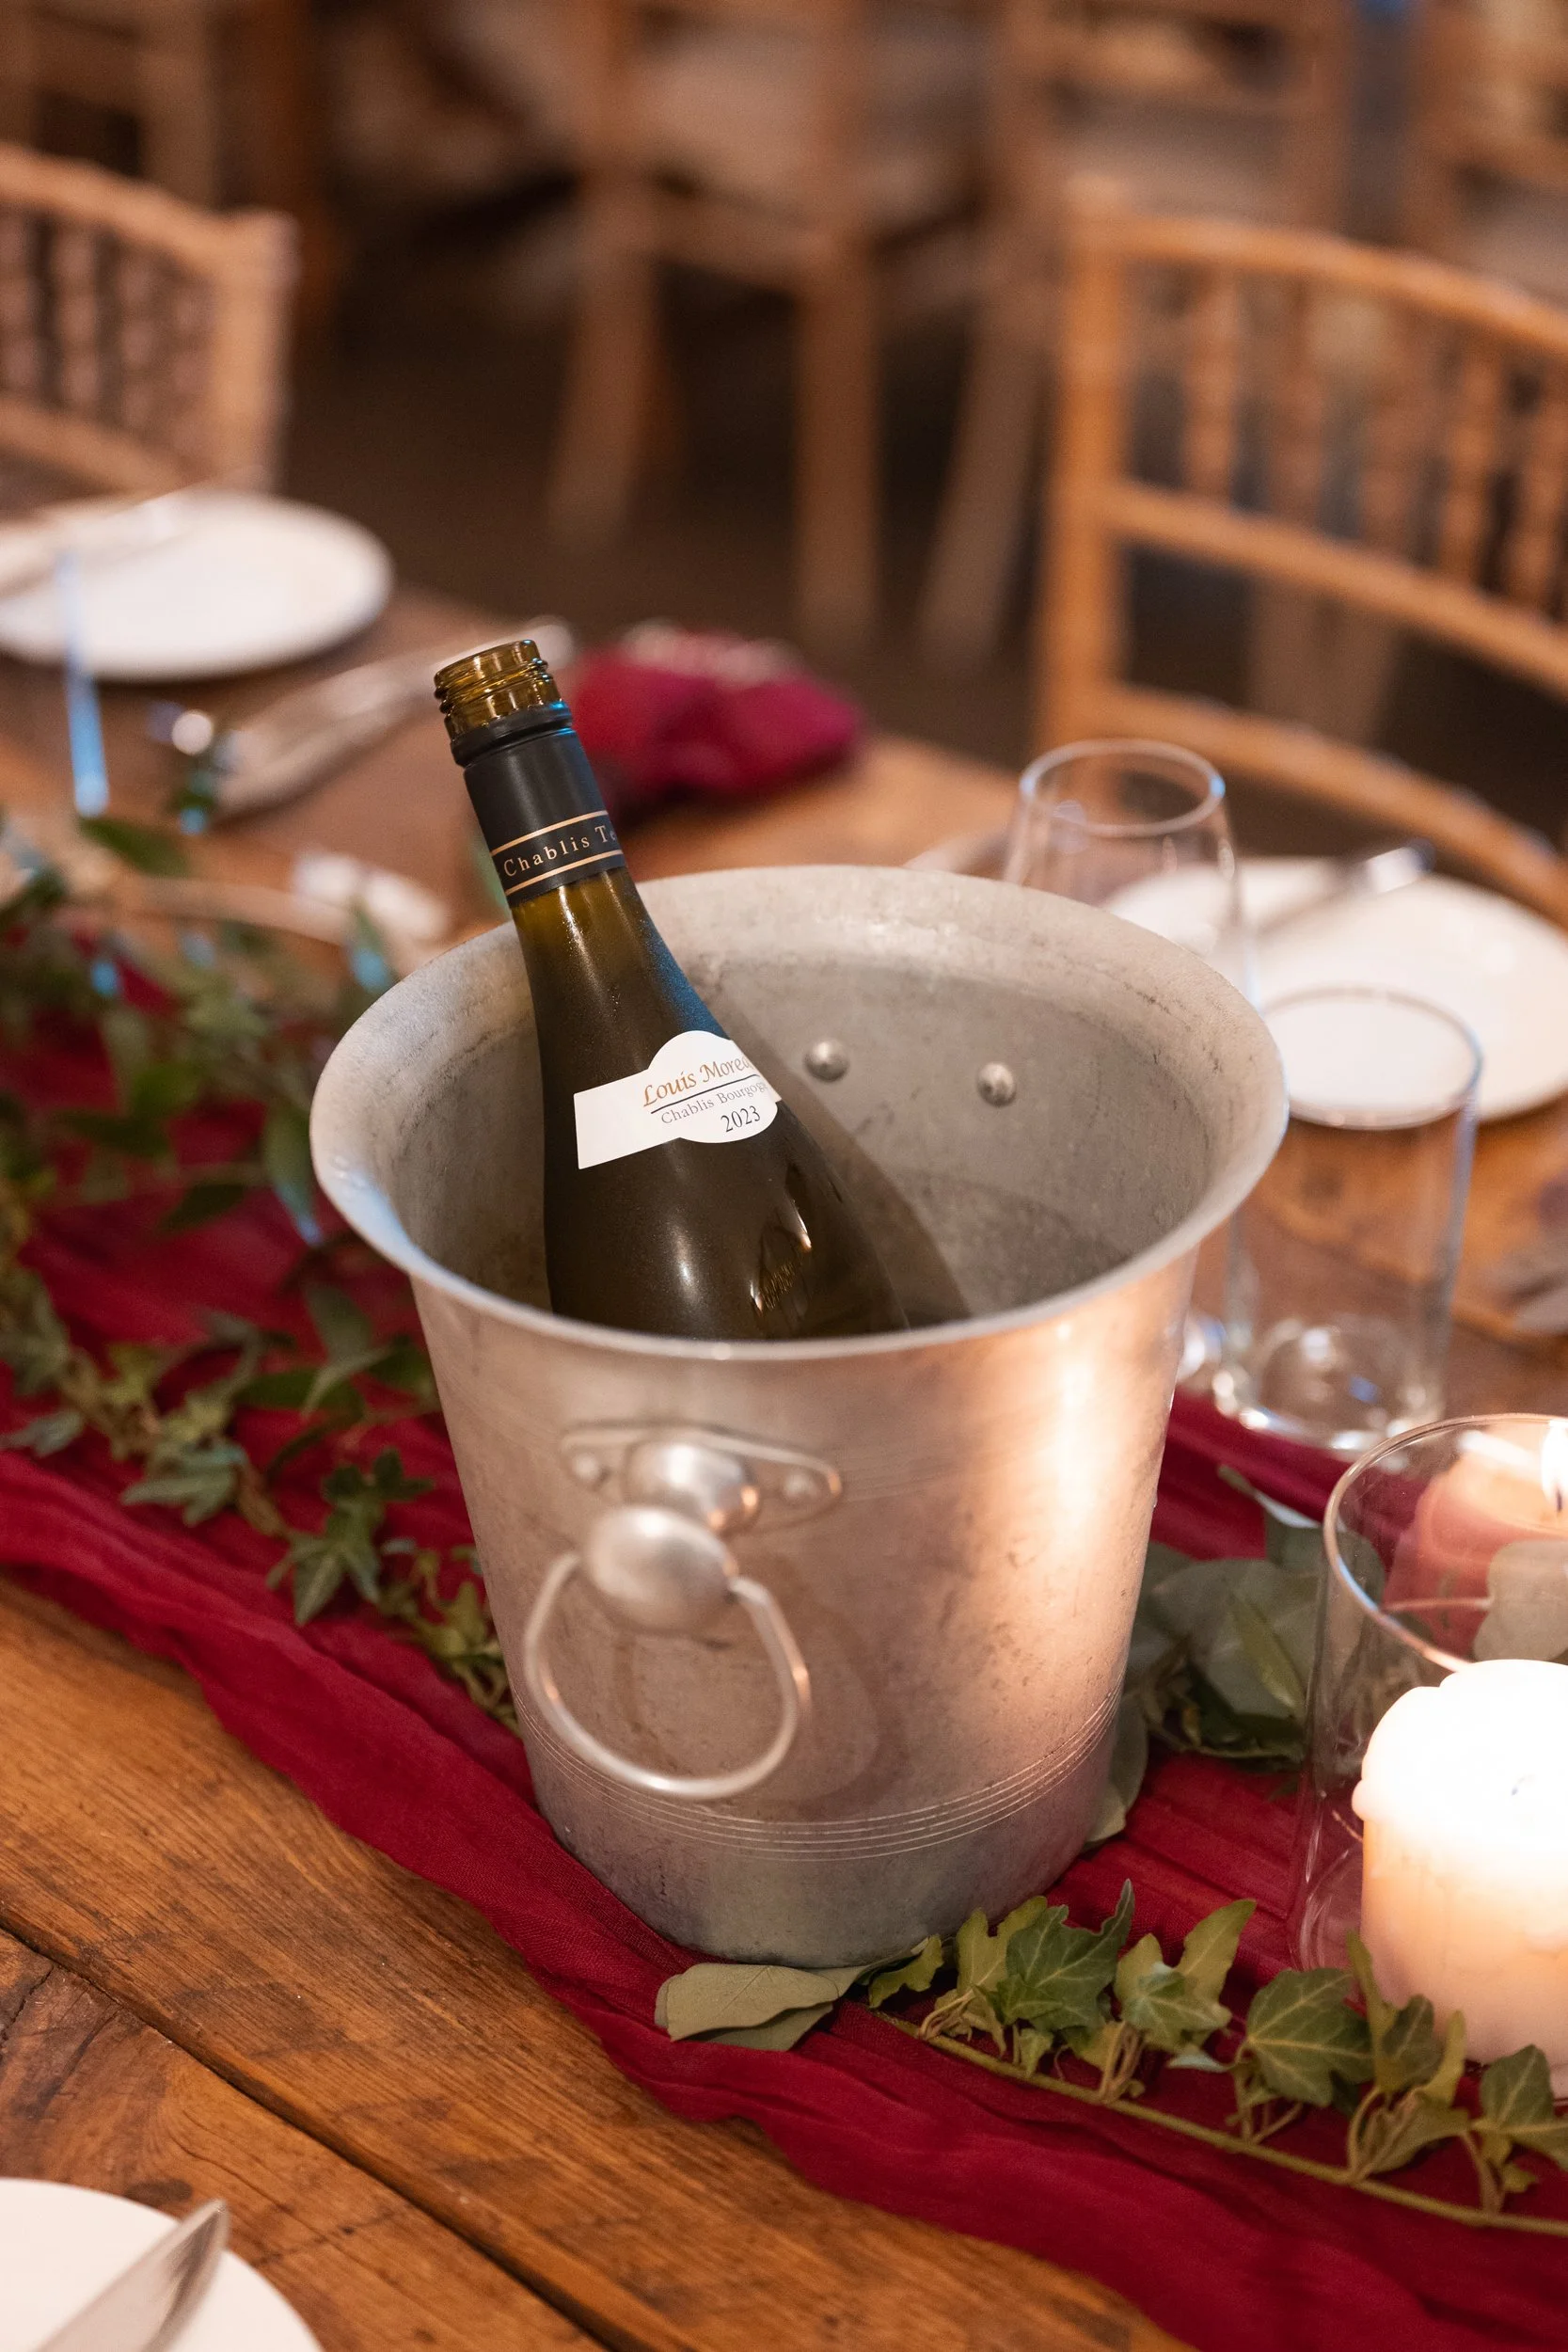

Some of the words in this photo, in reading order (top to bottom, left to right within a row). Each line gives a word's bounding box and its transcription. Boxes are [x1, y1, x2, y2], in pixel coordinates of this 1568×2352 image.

[503, 836, 590, 877] Chablis
[643, 1071, 697, 1107] Louis
[661, 1099, 715, 1124] Chablis
[721, 1104, 761, 1133] 2023
